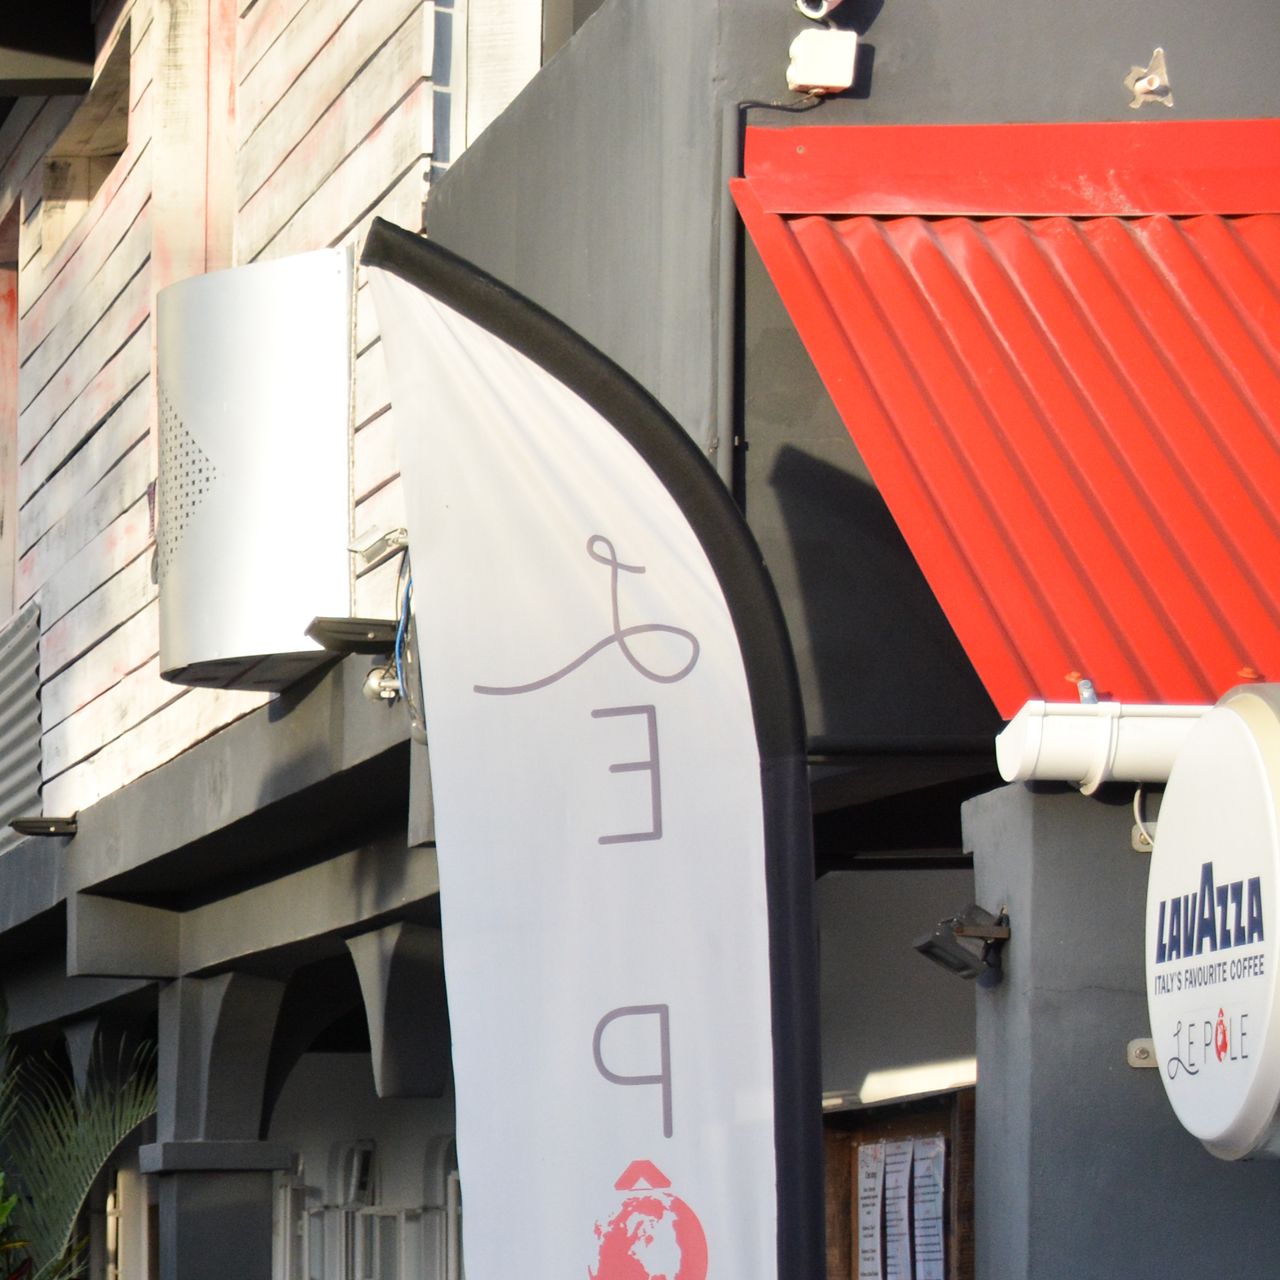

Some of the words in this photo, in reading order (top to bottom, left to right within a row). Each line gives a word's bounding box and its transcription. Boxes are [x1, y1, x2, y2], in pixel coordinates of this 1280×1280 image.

[1154, 971, 1182, 996] ITALY'S
[1184, 960, 1228, 989] FAVOURITE
[1229, 953, 1266, 982] COFFEE
